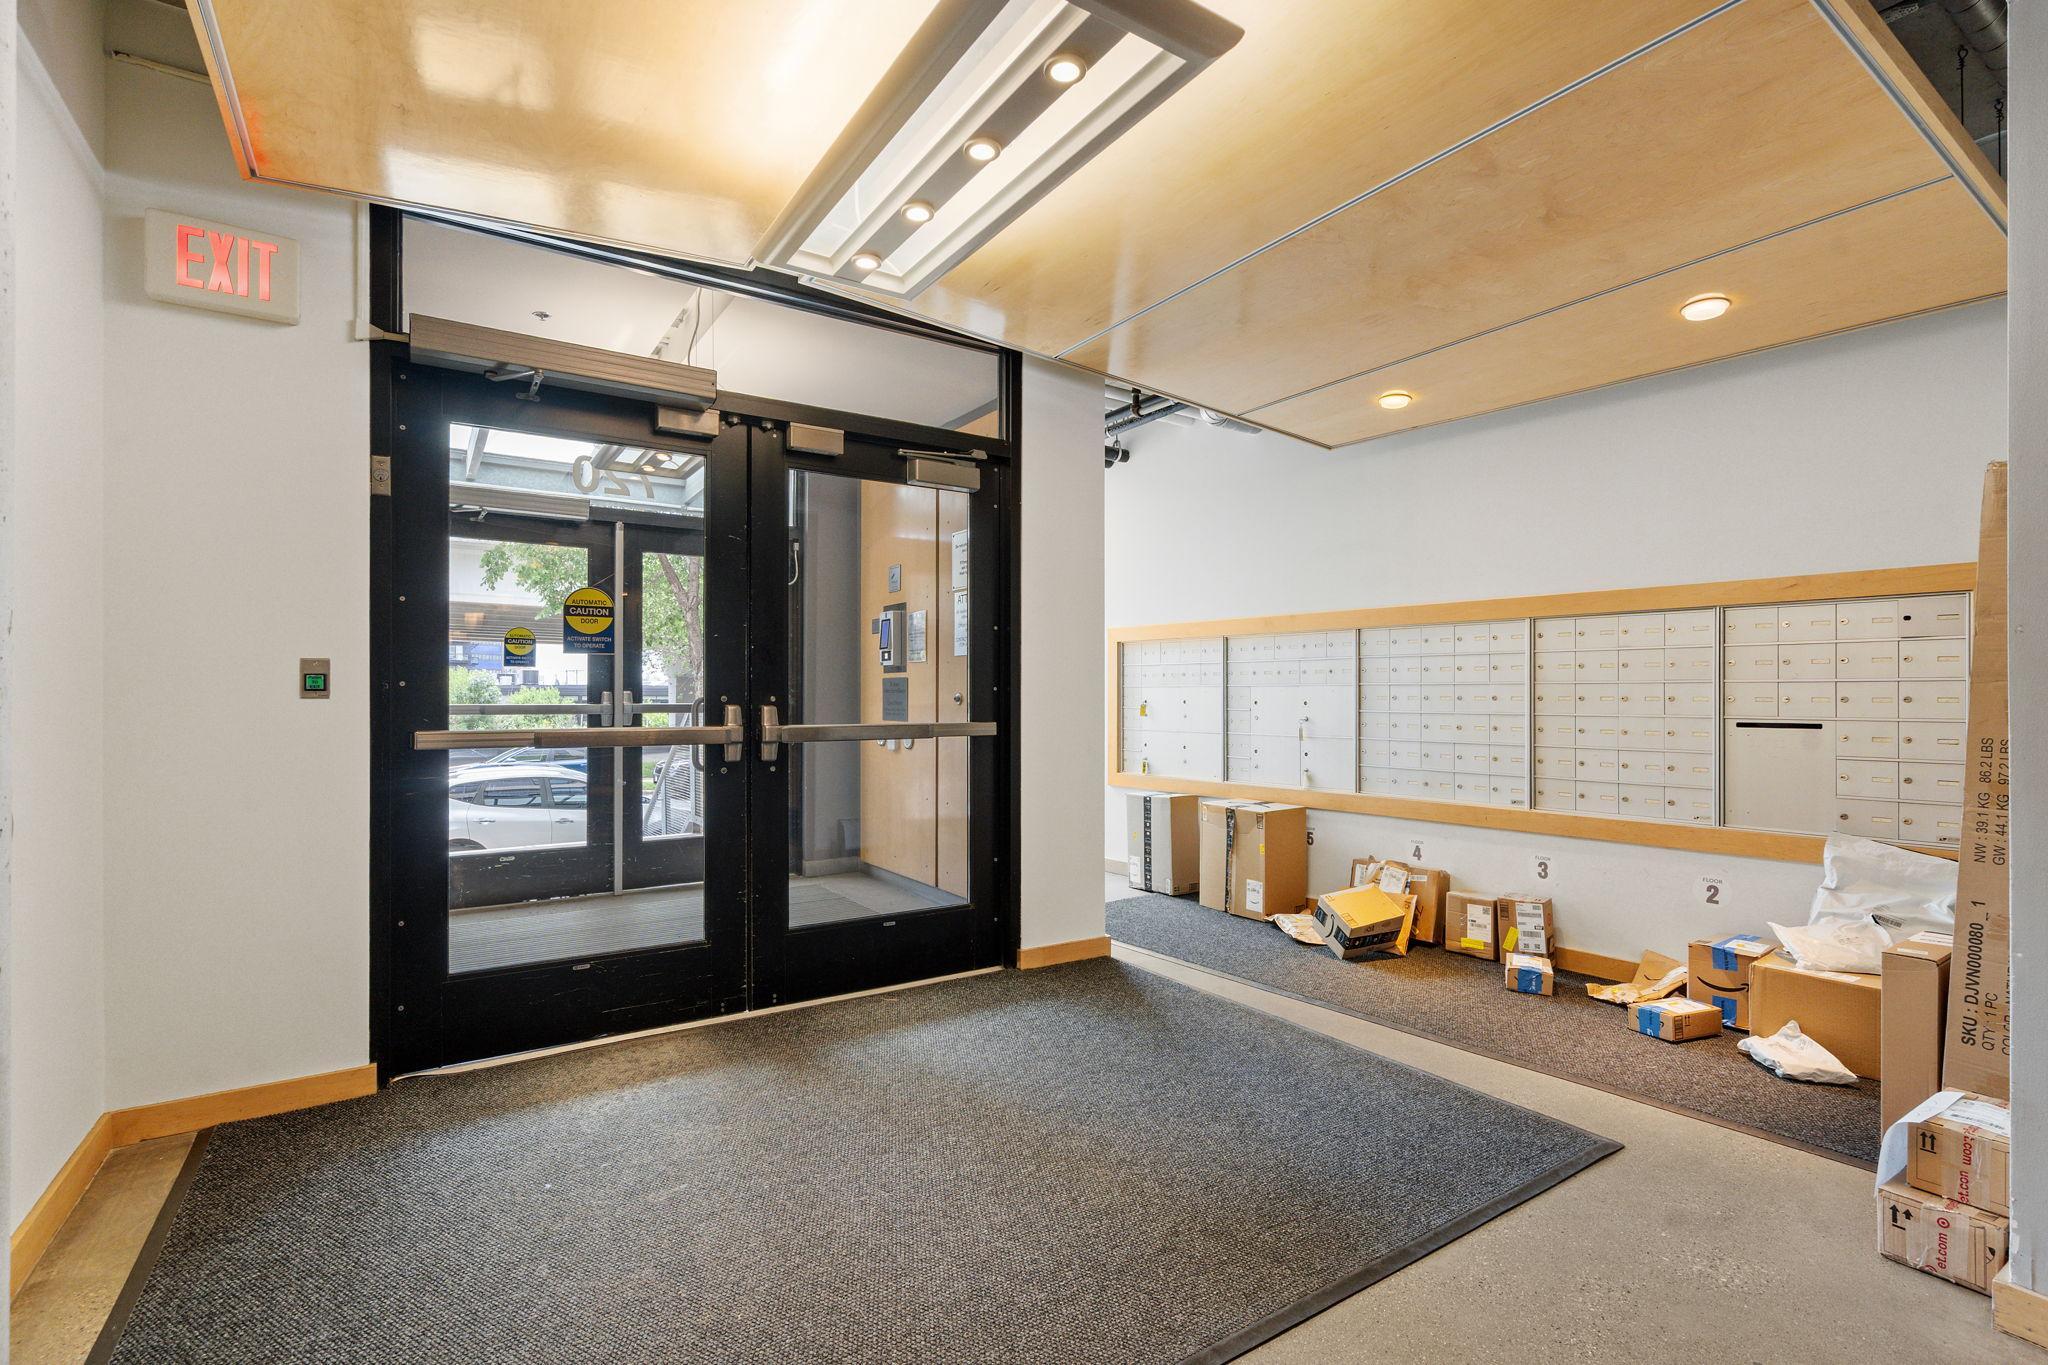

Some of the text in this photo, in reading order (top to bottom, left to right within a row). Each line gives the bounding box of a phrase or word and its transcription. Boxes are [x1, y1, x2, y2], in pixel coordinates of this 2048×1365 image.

[176, 223, 279, 302] EXIT
[569, 607, 609, 616] CAUTION
[1977, 791, 1991, 809] KG
[1996, 793, 2010, 812] KG
[1975, 811, 1989, 834] 39.1
[1995, 814, 2009, 837] 44.1
[1306, 831, 1314, 846] 5
[1412, 845, 1422, 861] 4
[1974, 843, 1987, 863] NW
[1992, 845, 2007, 866] GW
[1537, 861, 1549, 880] 3
[1702, 876, 1723, 884] FLOOR
[1706, 884, 1720, 905] 2
[1985, 992, 1998, 1011] PC
[1961, 1016, 1978, 1047] SKU
[1981, 1027, 1996, 1051] QTY
